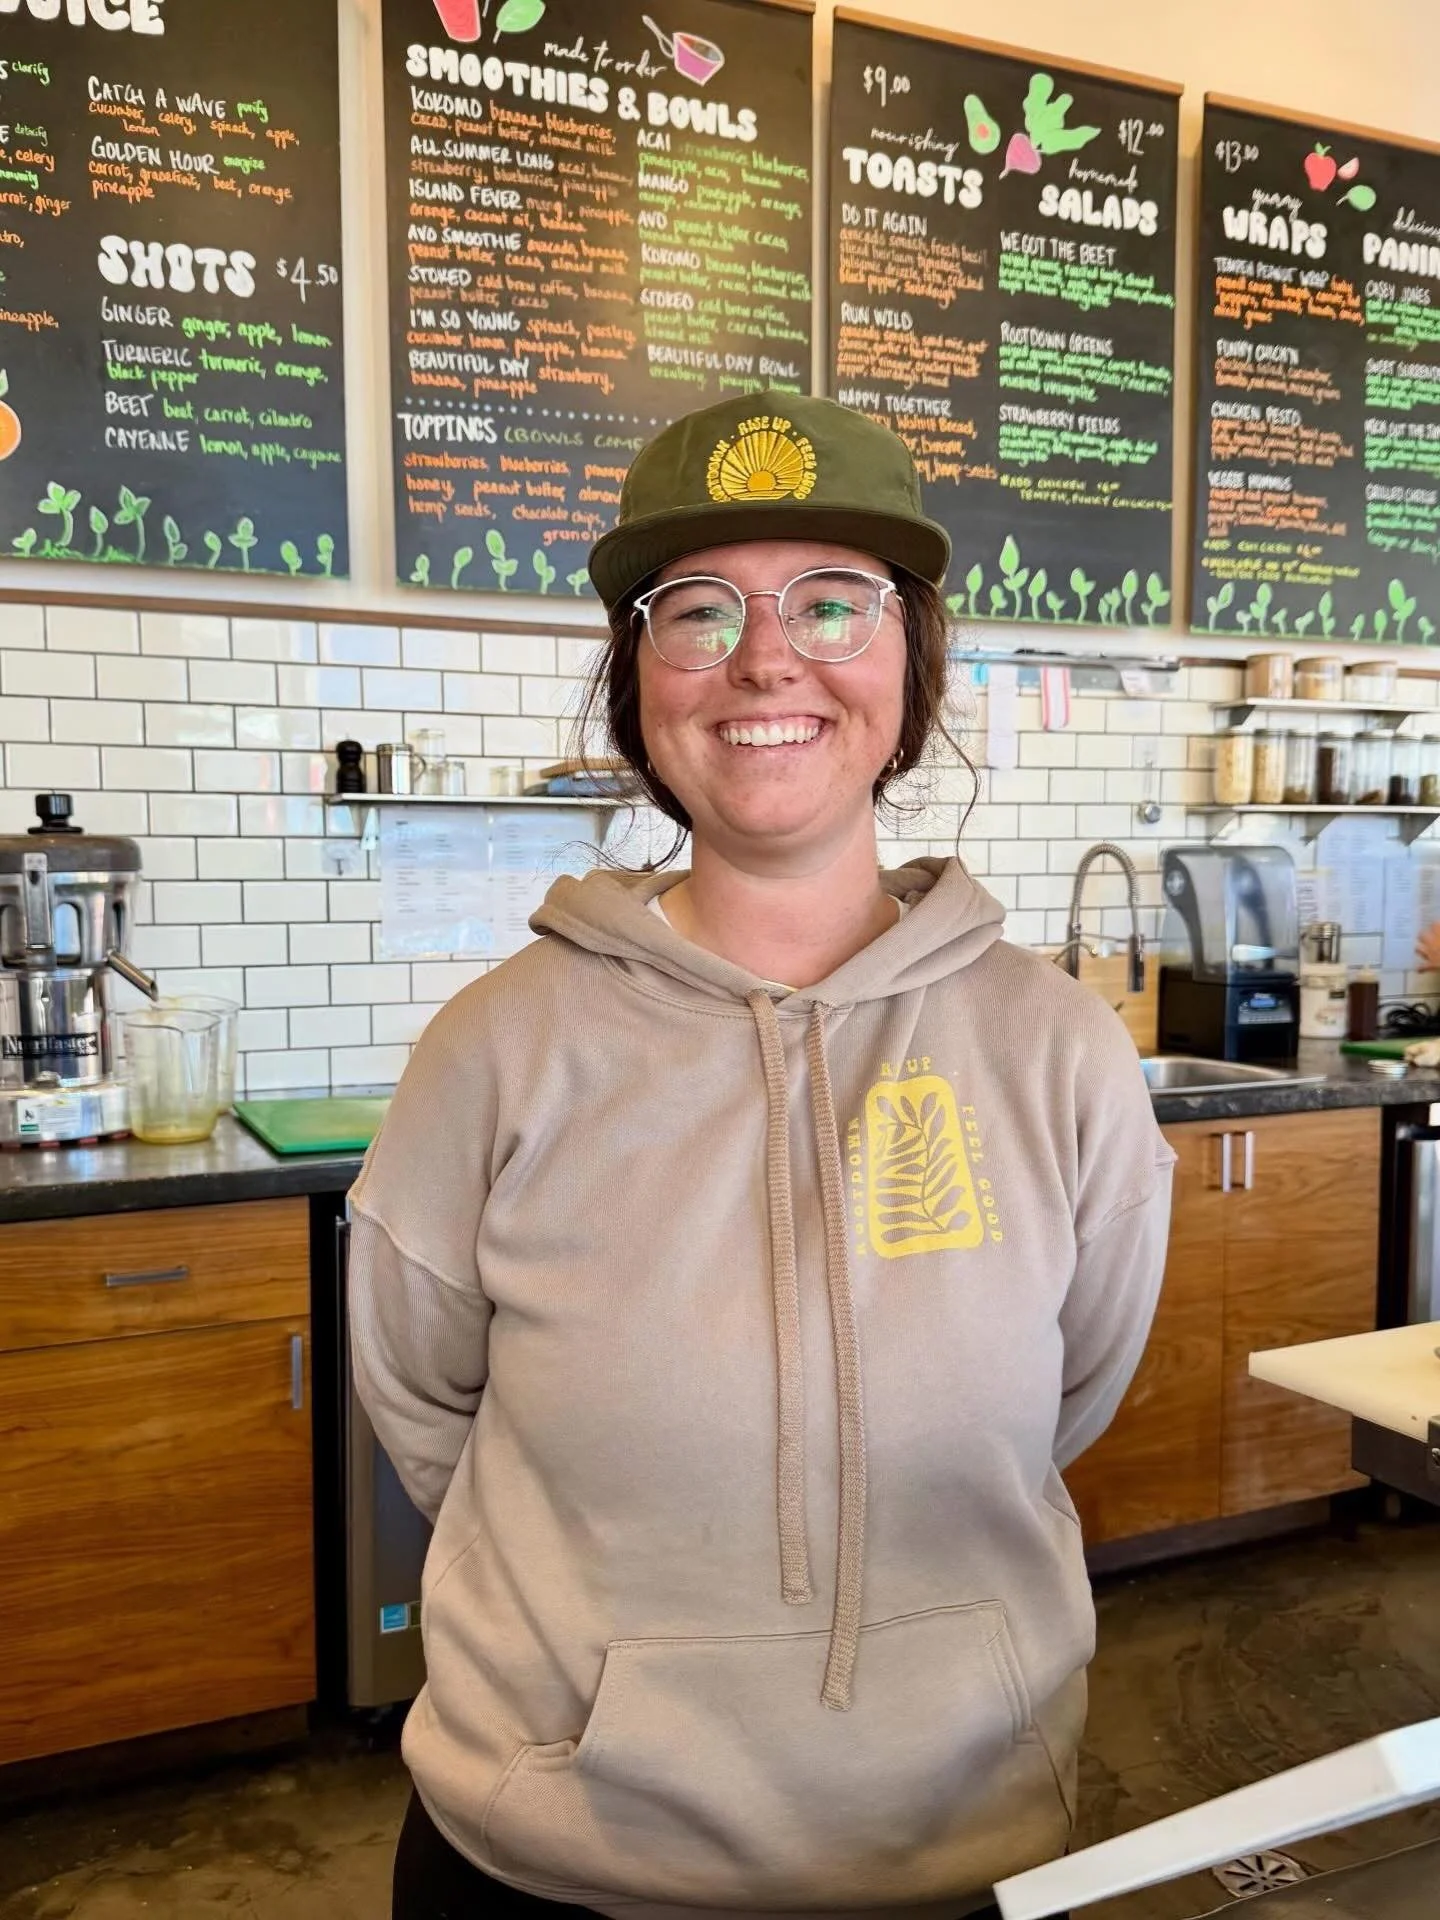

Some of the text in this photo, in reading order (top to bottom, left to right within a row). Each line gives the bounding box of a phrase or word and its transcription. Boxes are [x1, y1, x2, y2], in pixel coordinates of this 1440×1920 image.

[12, 61, 50, 85] clarify
[544, 36, 668, 79] made to order
[88, 76, 268, 123] CATCH A WAVE purify
[406, 44, 758, 142] SMOOTHIES & BOWLS
[863, 64, 911, 107] $9.00
[411, 85, 483, 119] KOKOMO
[123, 119, 160, 137] lemon
[158, 113, 197, 135] celery,
[210, 120, 256, 139] spinach,
[266, 129, 299, 150] apple,
[455, 119, 493, 137] peanut
[539, 133, 582, 151] almond
[637, 128, 670, 152] ACAI
[1118, 118, 1164, 156] $12.00
[15, 150, 55, 172] celery
[91, 136, 162, 165] GOLDEN
[169, 150, 220, 174] HOUR
[410, 135, 555, 170] ALL SUMMER LONG
[89, 161, 133, 184] carrot,
[213, 177, 242, 198] beet,
[249, 184, 293, 205] orange
[92, 180, 155, 204] pineapple
[409, 178, 523, 210] ISLAND FEVER
[638, 172, 689, 194] MANGO
[842, 147, 984, 209] TOASTS
[35, 194, 71, 217] ginger
[410, 203, 460, 227] orange,
[638, 210, 667, 230] AVO
[842, 202, 928, 237] DO IT AGAIN
[1038, 184, 1159, 236] SALADS
[408, 224, 521, 251] AVO SMOOTHIE
[1000, 230, 1116, 266] WE GOT THE BEET
[1222, 205, 1328, 259] WRAPS
[98, 235, 338, 304] SHOTS $4.50
[641, 243, 701, 269] KOKOMO
[408, 265, 472, 287] STOKED
[640, 288, 694, 311] STOKED
[101, 296, 174, 328] GINGER
[182, 317, 232, 342] ginger,
[238, 321, 282, 349] apple,
[409, 308, 520, 331] I'M SO YOUNG
[841, 301, 913, 331] RUN WILD
[1000, 320, 1113, 357] ROOTDOWN GREENS
[102, 339, 329, 387] TURMERIC turmeric, orange,
[107, 361, 199, 392] black pepper
[409, 349, 495, 374] BEAUTIFUL
[499, 357, 529, 378] DAY
[647, 344, 801, 377] BEAUTIFUL DAY BOWL
[105, 391, 154, 418] BEET
[204, 407, 254, 430] carrot,
[259, 408, 312, 429] cilantro
[839, 388, 953, 418] HAPPY TOGETHER
[999, 403, 1121, 435] STRAWBERRY FIELDS
[1265, 405, 1302, 426] PESTO
[104, 426, 189, 452] CAYENNE
[397, 412, 498, 444] TOPPINGS
[504, 426, 584, 446] (BOWLS
[738, 416, 791, 436] RISE UP
[796, 438, 817, 469] FEEL
[473, 480, 521, 501] peanut
[793, 471, 817, 500] GOOD
[409, 497, 447, 523] hemp
[907, 1056, 932, 1073] UP
[960, 1105, 984, 1162] FEEL
[977, 1178, 1003, 1241] GOOD
